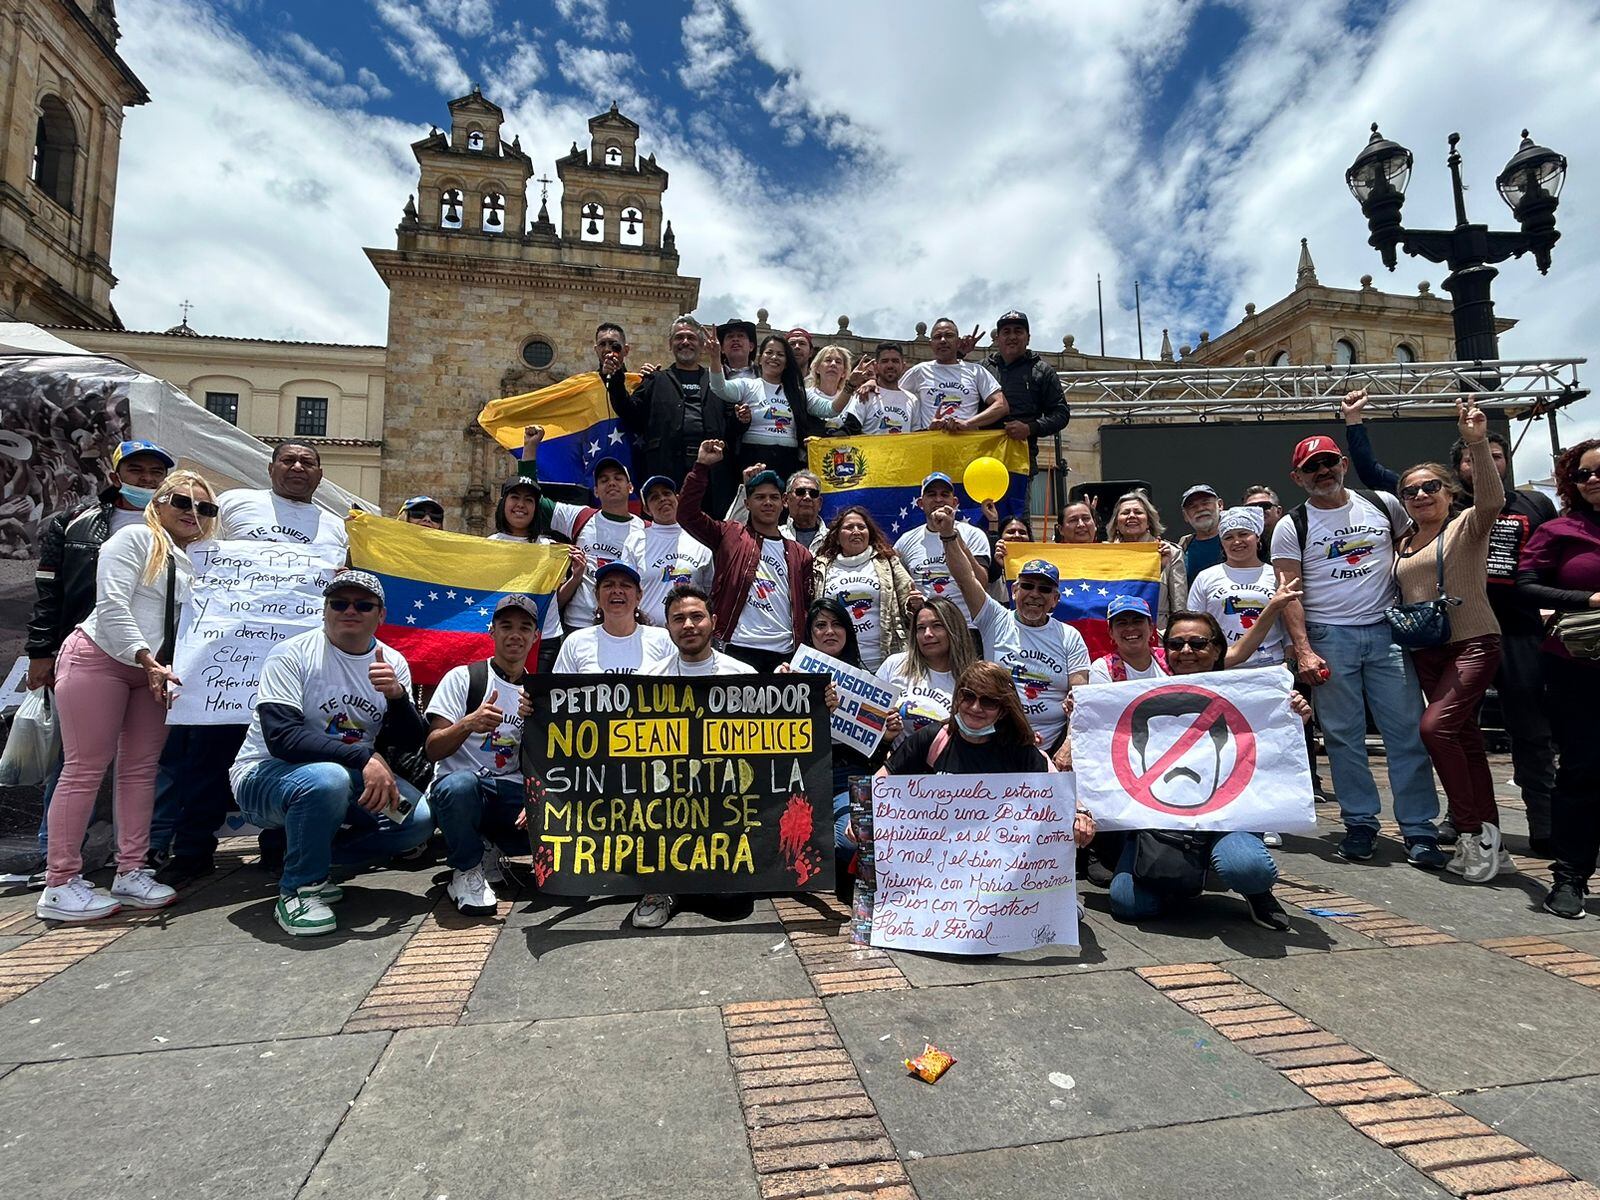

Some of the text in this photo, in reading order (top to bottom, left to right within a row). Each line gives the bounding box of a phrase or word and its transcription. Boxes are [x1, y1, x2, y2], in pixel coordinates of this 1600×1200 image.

[938, 382, 970, 395] QUIERO
[872, 406, 909, 422] TE QUIERO
[1305, 438, 1320, 451] V
[1495, 519, 1519, 527] LANO
[247, 525, 312, 544] TE QUIER
[592, 543, 622, 558] QUIER
[923, 555, 947, 566] QUIE
[194, 547, 252, 578] Tengo
[652, 553, 699, 569] TE QUIERO
[197, 573, 241, 592] tengo
[313, 572, 330, 588] Ven
[1331, 564, 1372, 580] LIBRE
[825, 576, 881, 596] TE QUIERO
[1213, 587, 1228, 599] TE
[229, 600, 251, 613] no
[261, 603, 287, 615] me
[203, 625, 287, 641] mi derecho
[851, 619, 875, 634] BRE
[213, 645, 260, 672] Elegir
[1000, 649, 1062, 673] TE QUIERO
[201, 665, 260, 691] Preferido
[247, 692, 258, 711] C
[319, 694, 382, 722] TE QUIERO
[550, 683, 810, 718] PETRO, LULA, OBRADOR
[838, 696, 859, 716] LA
[1022, 701, 1049, 715] BRE
[546, 719, 811, 759] NO SEAN COMPLICES
[831, 714, 877, 748] RACIA
[545, 758, 805, 794] SIN LIBERTAD LA
[873, 776, 1054, 805] En Venezuela estamos
[723, 794, 762, 828] SE
[954, 808, 989, 821] una
[874, 824, 1074, 848] espiritual, es el Bien contra
[876, 849, 894, 863] el
[949, 853, 967, 867] el
[967, 850, 1002, 869] bien
[1005, 853, 1059, 877] siempre
[941, 879, 963, 890] con
[889, 891, 928, 911] Dios
[931, 899, 958, 914] con
[872, 908, 919, 942] Hasta
[922, 920, 938, 938] el
